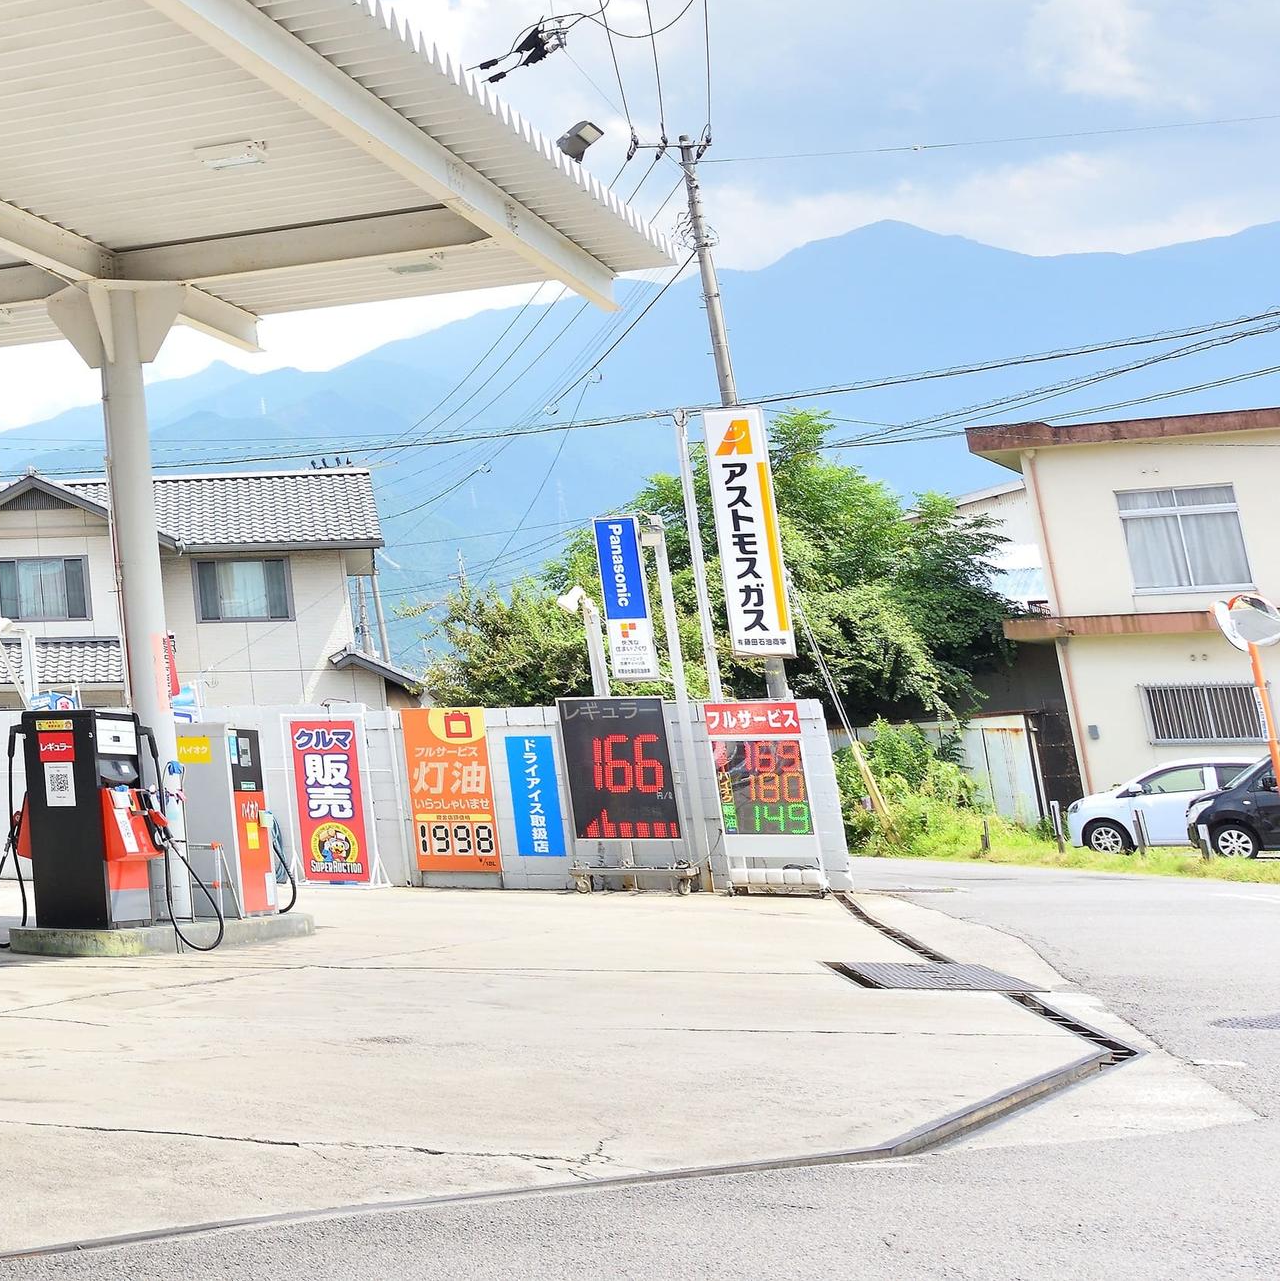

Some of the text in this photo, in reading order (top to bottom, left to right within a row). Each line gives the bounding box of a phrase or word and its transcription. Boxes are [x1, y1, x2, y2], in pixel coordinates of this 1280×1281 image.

[721, 462, 770, 632] アストモスガス
[608, 524, 632, 608] Panasonic
[563, 702, 658, 720] レギュラー
[706, 709, 798, 729] フルサービス
[40, 742, 72, 751] レギュラー
[179, 746, 208, 754] ハイオク
[295, 730, 351, 749] クルマ
[415, 746, 478, 757] フルサービス
[413, 761, 487, 795] 灯油
[592, 734, 664, 793] 166
[304, 753, 353, 819] 販売
[523, 739, 549, 853] ドライアイス取扱店
[749, 772, 805, 803] 180
[414, 798, 490, 810] いらっしゃいませ
[754, 803, 810, 834] 149
[420, 824, 494, 853] 1998
